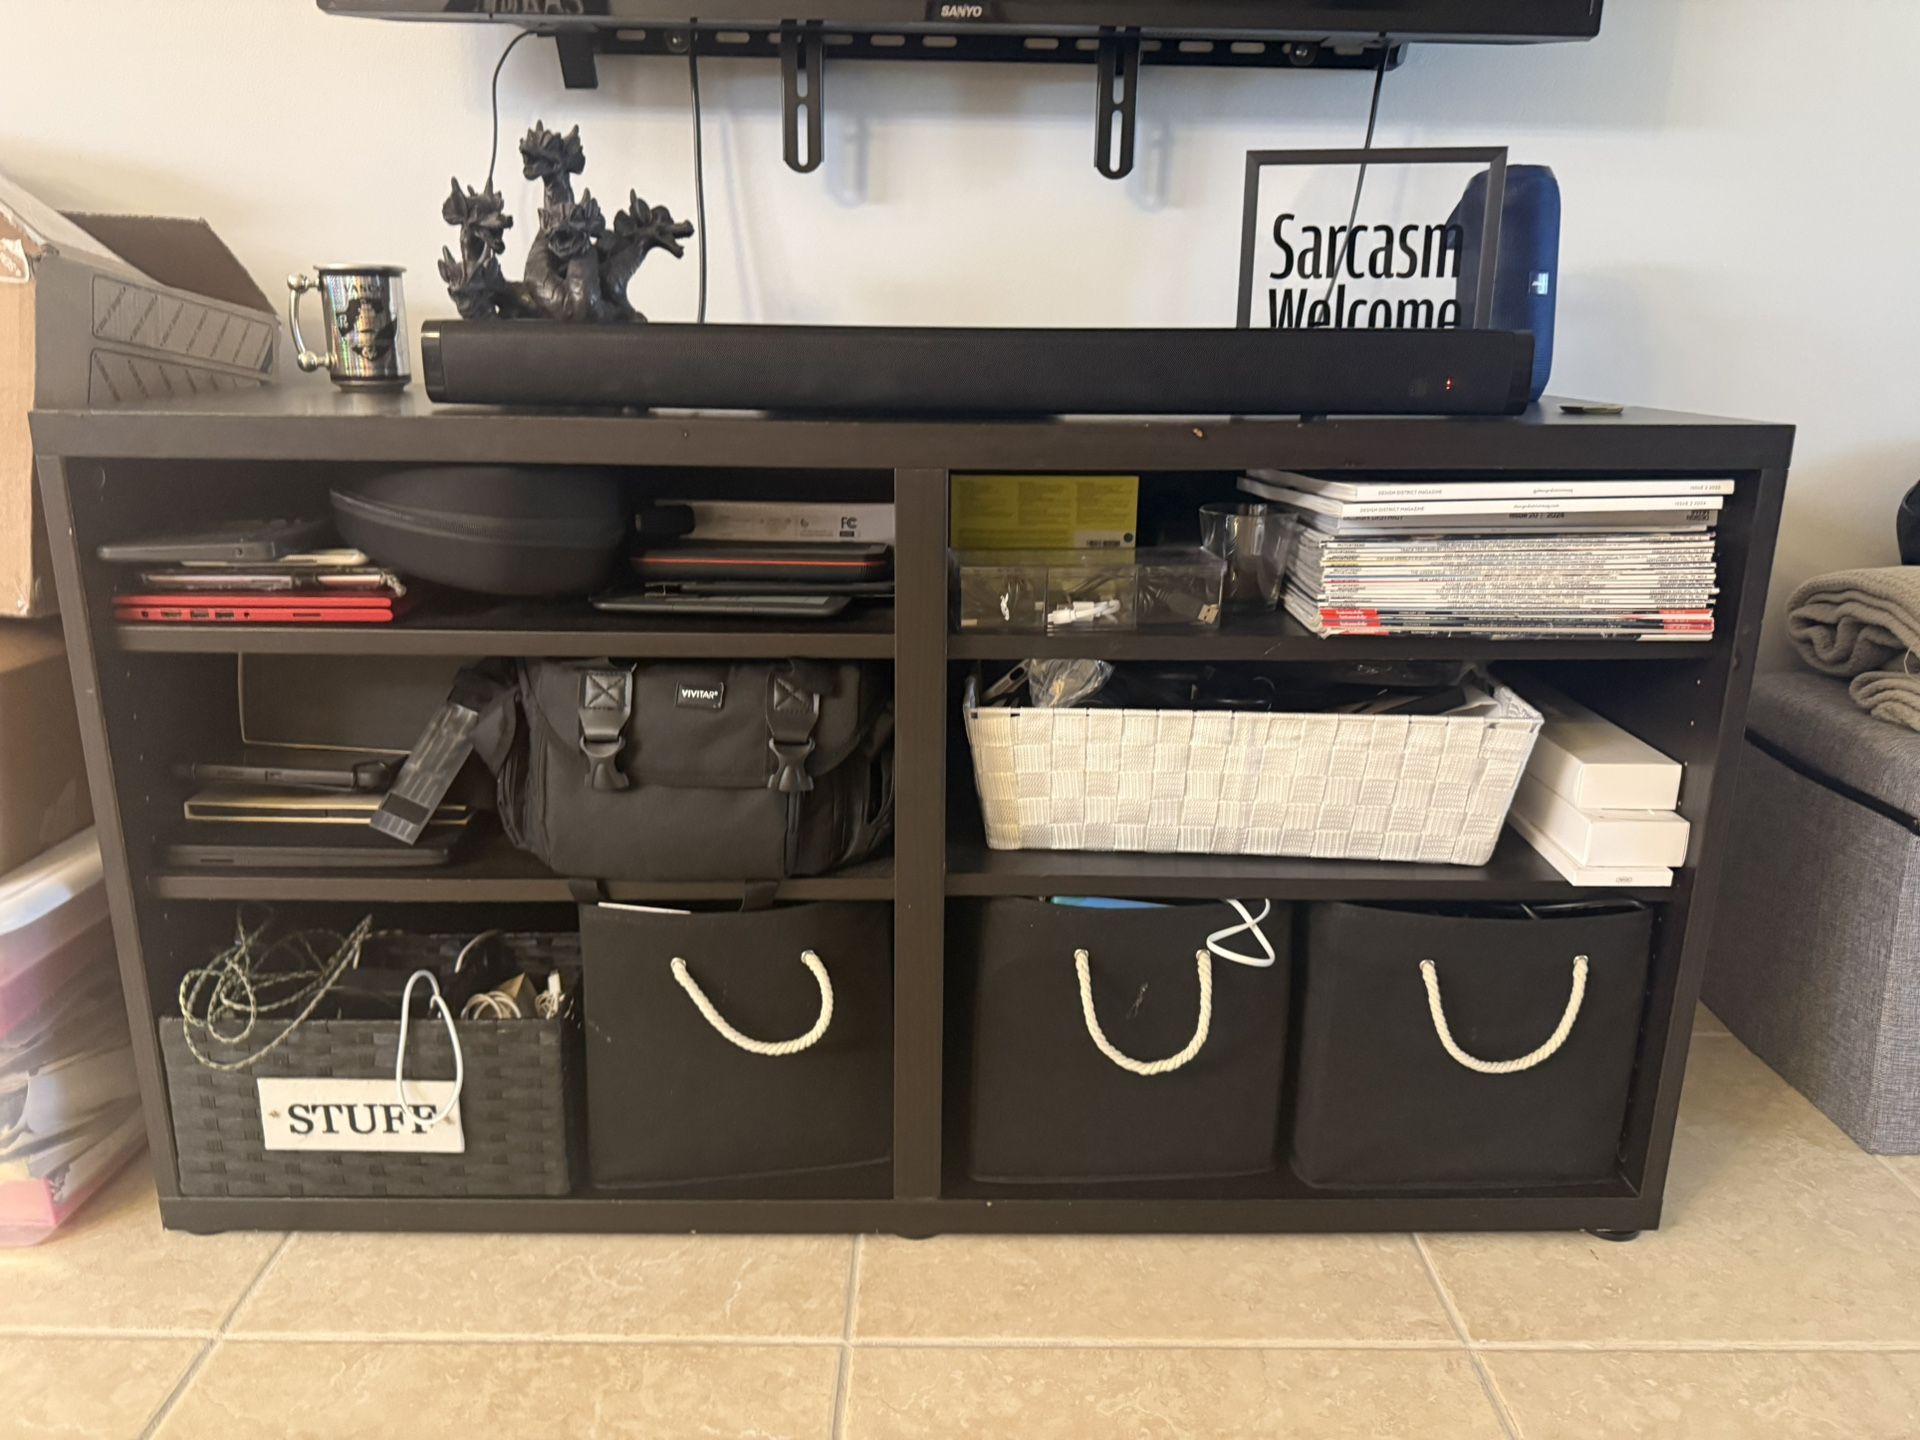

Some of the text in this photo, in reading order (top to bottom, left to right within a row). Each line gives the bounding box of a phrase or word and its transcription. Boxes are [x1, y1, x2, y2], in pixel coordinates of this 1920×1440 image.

[941, 5, 983, 18] SANYO
[1269, 213, 1464, 279] Sarcasm
[1268, 283, 1462, 329] Welcome
[287, 1103, 438, 1135] STUFF
